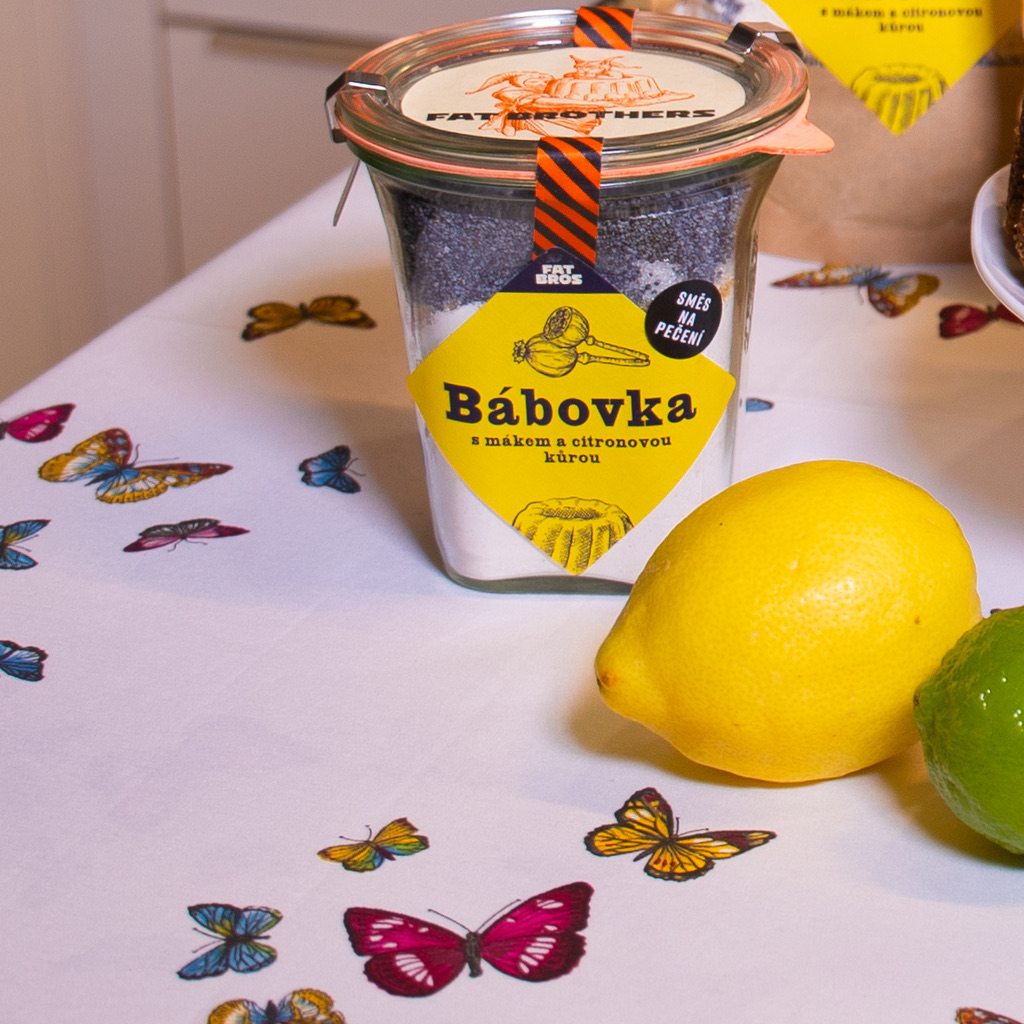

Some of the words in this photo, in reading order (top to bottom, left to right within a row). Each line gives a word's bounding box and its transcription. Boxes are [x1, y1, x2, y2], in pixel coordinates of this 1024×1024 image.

[426, 112, 499, 122] FAT
[506, 109, 716, 121] BROTHERS
[542, 264, 575, 274] FAT
[535, 273, 583, 285] BROS
[676, 291, 712, 311] SMĚS
[677, 309, 697, 327] NA
[654, 321, 706, 347] PEČENÍ
[443, 381, 697, 427] Bábovka
[471, 436, 479, 446] s
[485, 434, 551, 447] mákem
[556, 438, 566, 447] a
[572, 436, 672, 448] citronovou
[544, 450, 600, 464] kůrou
